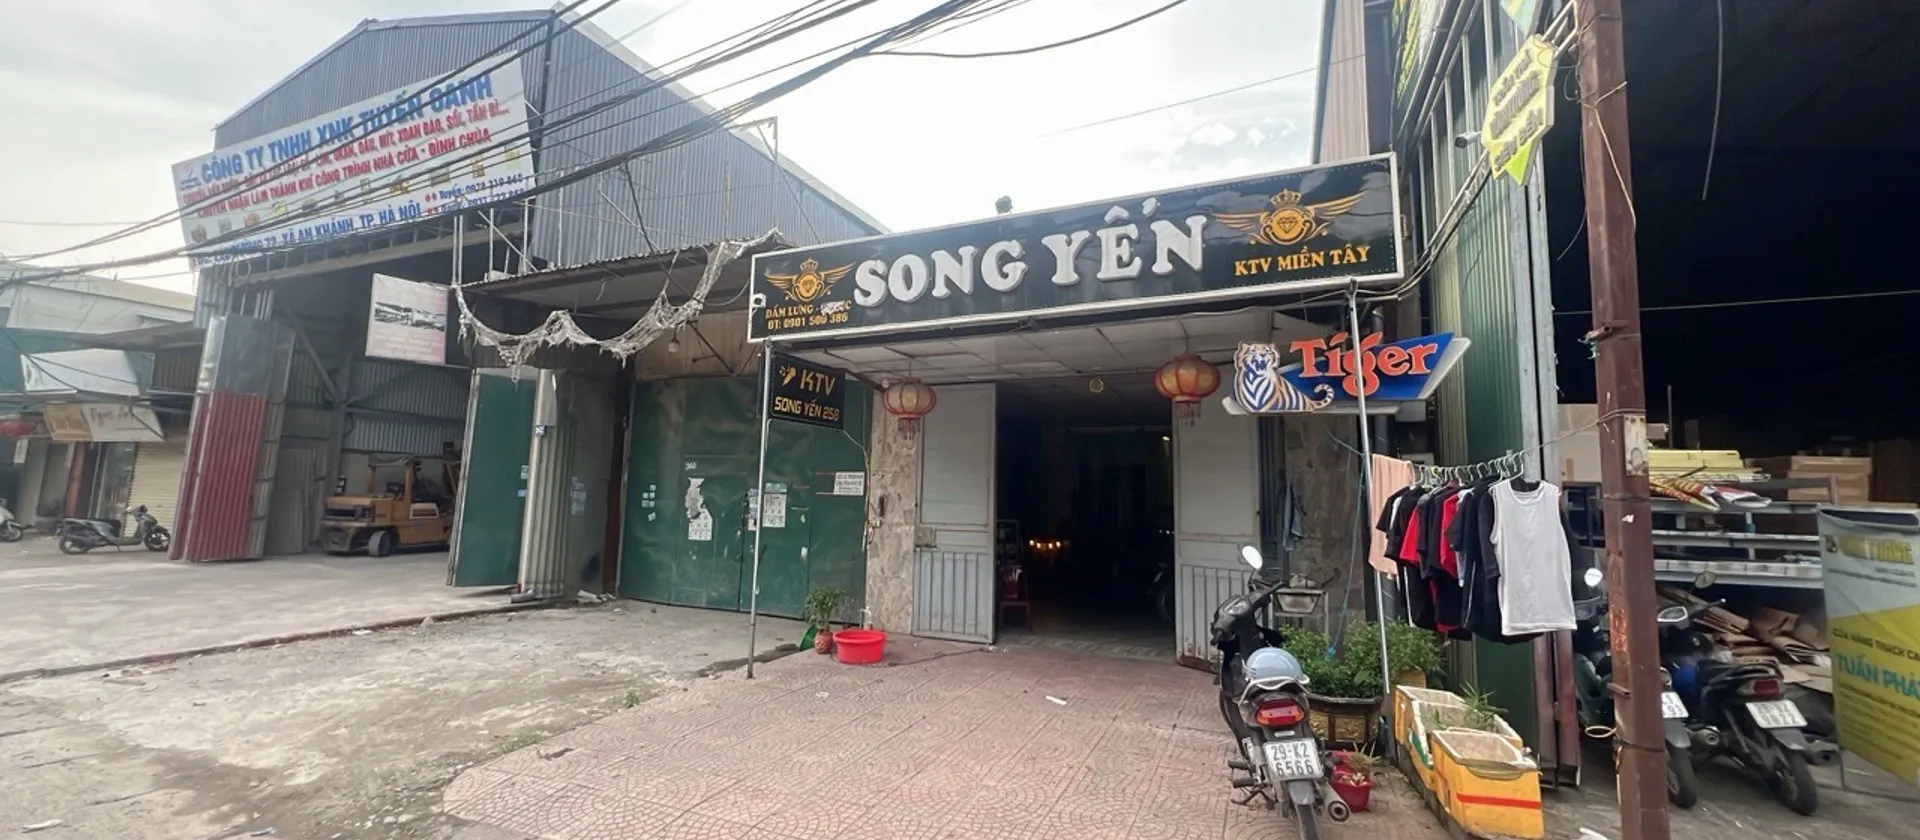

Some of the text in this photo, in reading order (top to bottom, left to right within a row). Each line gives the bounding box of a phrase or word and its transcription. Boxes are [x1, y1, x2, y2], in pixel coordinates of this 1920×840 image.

[201, 152, 243, 182] CÔNG
[245, 145, 264, 170] TY
[268, 130, 311, 163] TNHH
[315, 168, 341, 186] CÔNG
[342, 161, 371, 180] TRÌNH
[373, 152, 395, 172] NHÀ
[378, 204, 396, 224] HÀ
[853, 196, 1208, 307] SONG YẾN
[1234, 243, 1371, 276] KTV MIỀN TÂY
[1290, 331, 1439, 397] Tiger
[800, 368, 836, 396] KTV
[773, 395, 802, 414] SONG
[803, 396, 822, 418] YẾN
[1271, 742, 1310, 761] 29-K2
[1275, 759, 1314, 777] 6566
